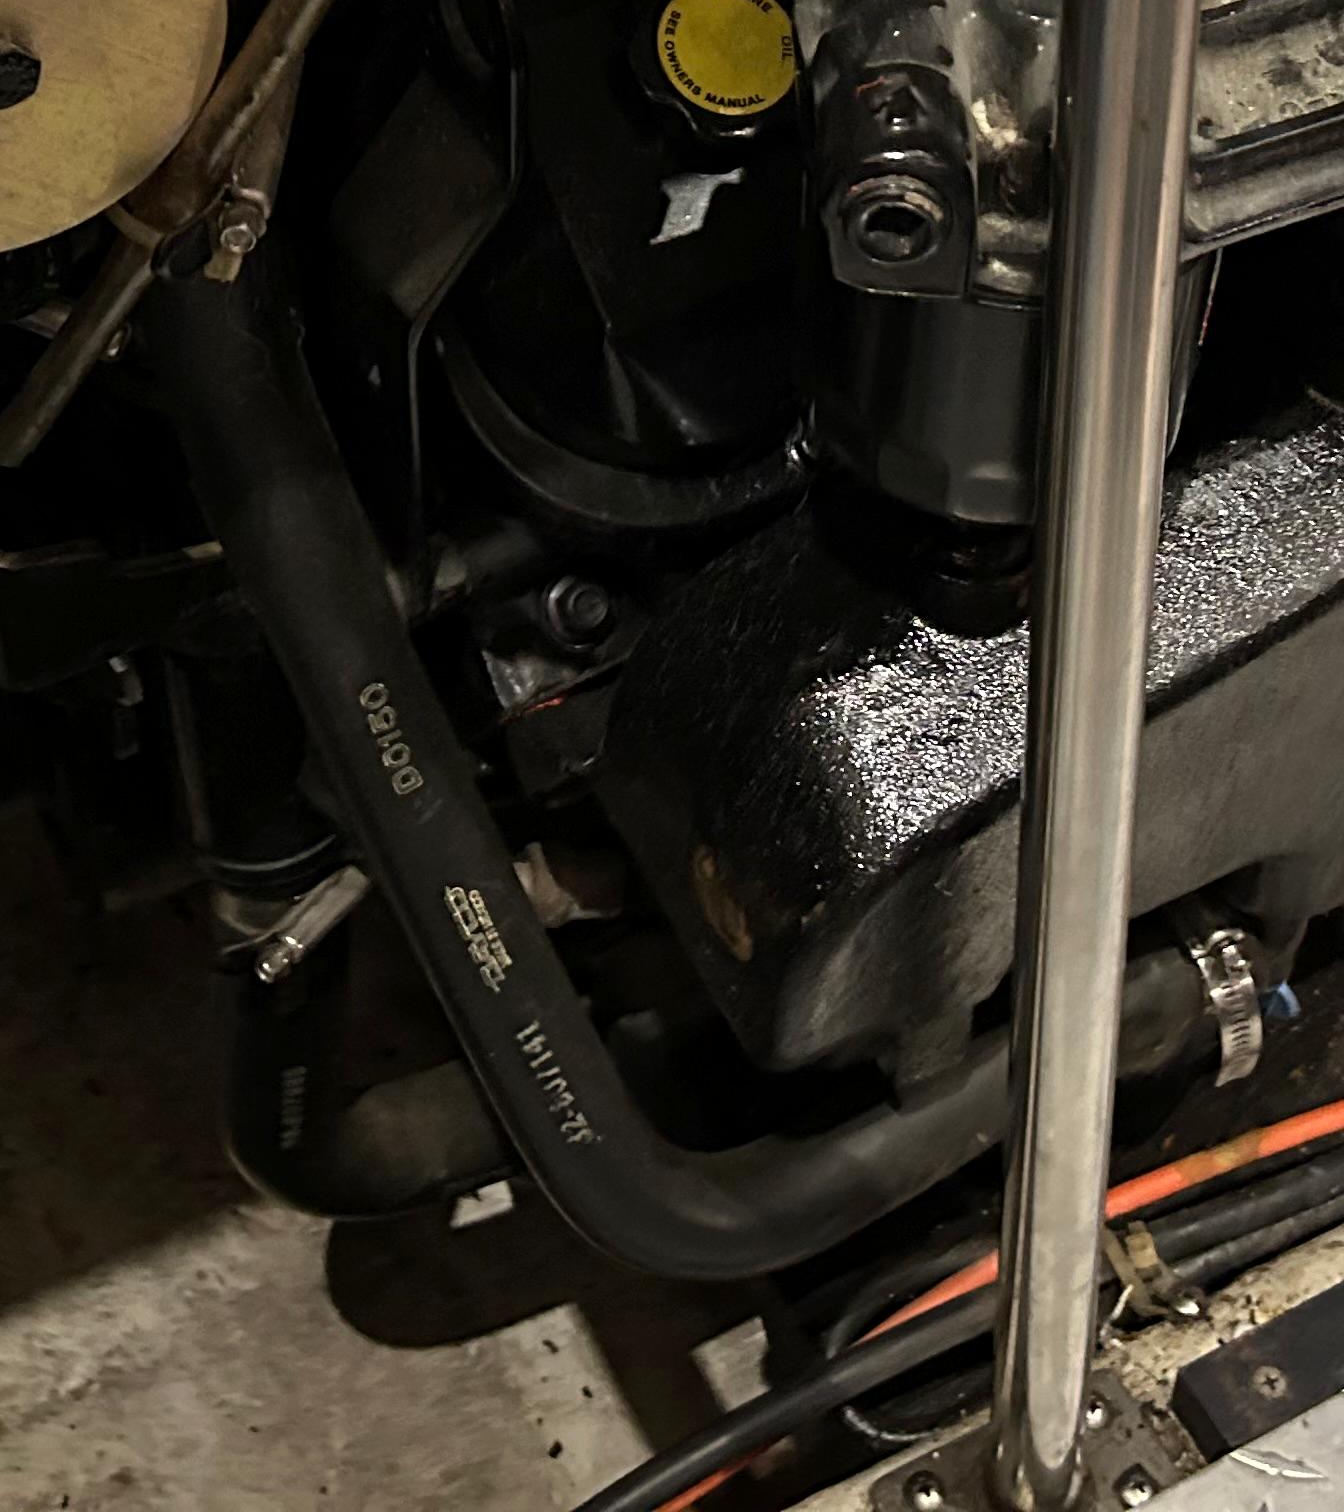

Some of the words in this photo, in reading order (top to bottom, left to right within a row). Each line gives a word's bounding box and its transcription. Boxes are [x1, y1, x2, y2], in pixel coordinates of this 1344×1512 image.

[664, 10, 682, 37] SEE
[781, 35, 794, 62] OIL
[663, 40, 703, 96] OWNERS
[704, 92, 767, 108] MANUAL
